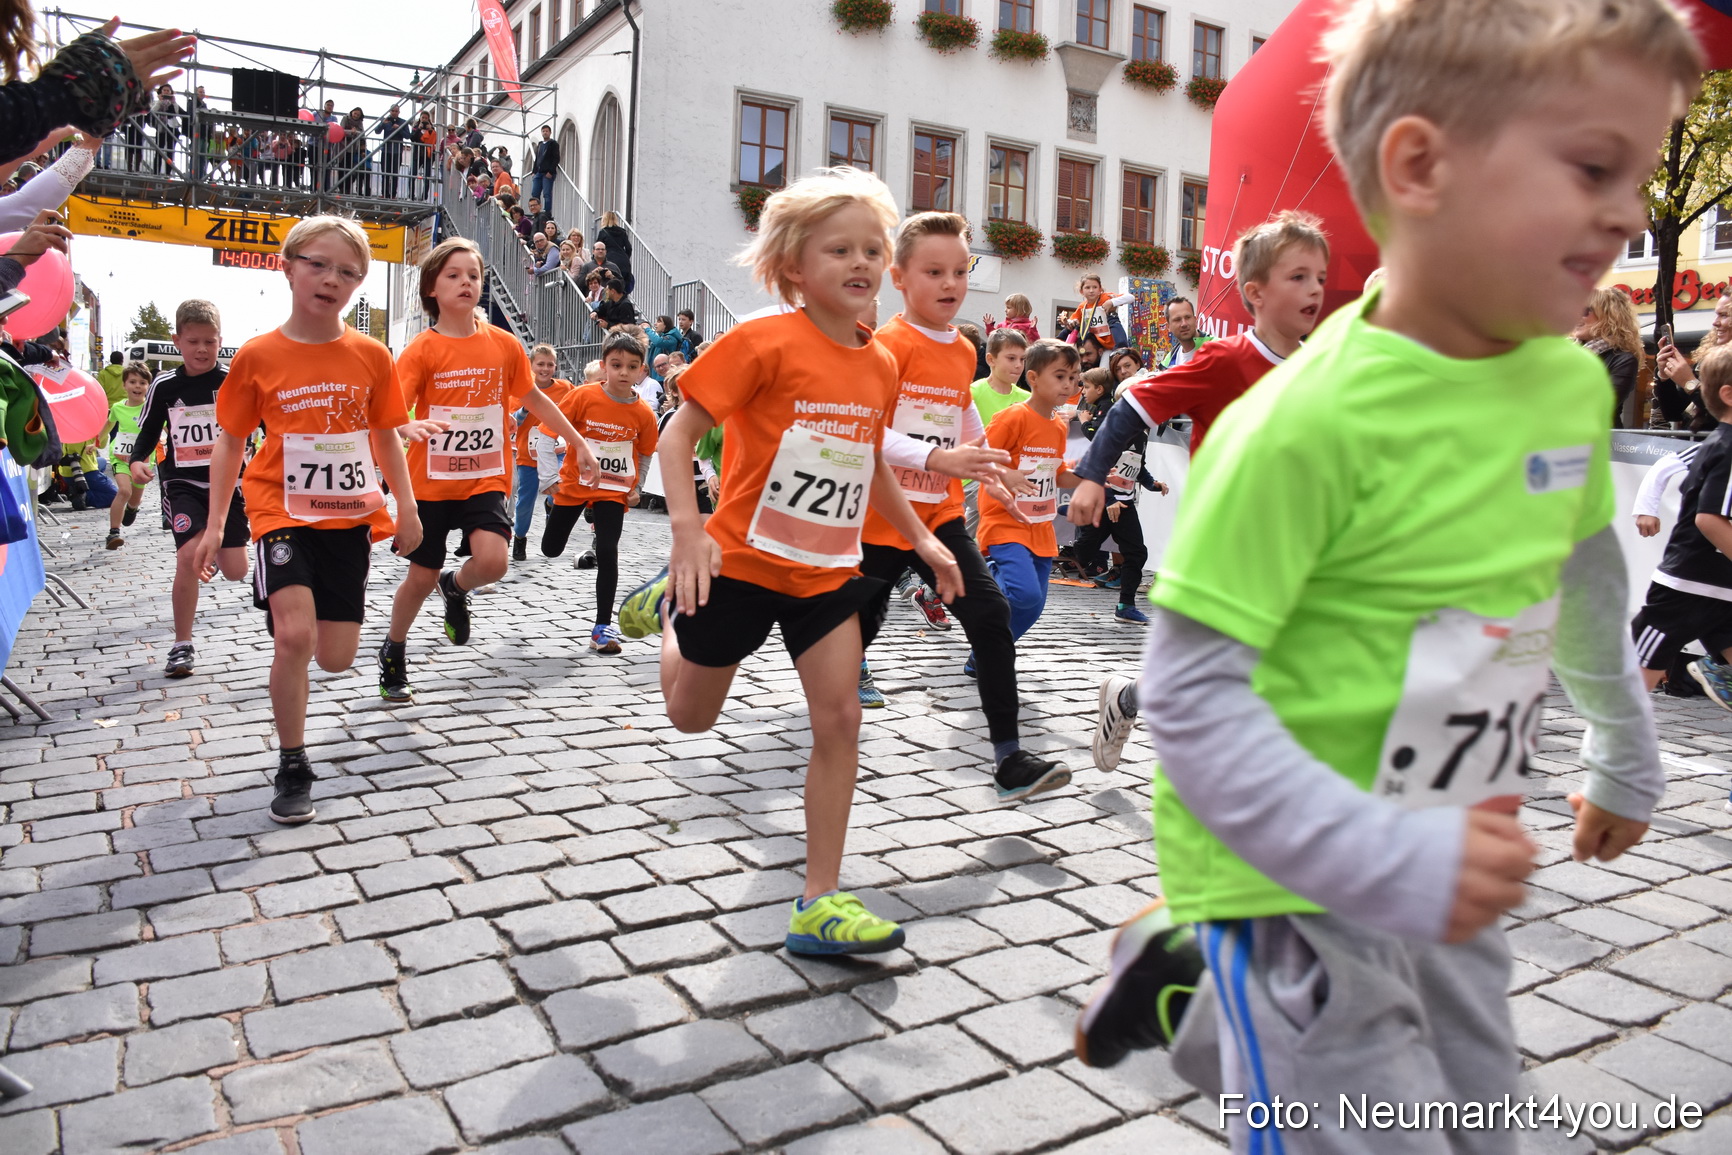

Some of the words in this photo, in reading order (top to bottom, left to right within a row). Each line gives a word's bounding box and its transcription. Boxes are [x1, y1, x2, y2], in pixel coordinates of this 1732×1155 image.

[205, 217, 280, 245] ZIEL
[1202, 245, 1237, 279] STO
[1672, 269, 1732, 311] Bec
[1091, 315, 1103, 326] 94
[157, 344, 183, 355] MIN
[433, 367, 486, 380] Neumarkter
[277, 382, 347, 401] Neumarkter
[434, 378, 476, 389] Stadtlauf
[901, 381, 959, 398] Neumarkter
[281, 395, 334, 414] Stadtlauf
[794, 400, 872, 418] Neumarkter
[586, 419, 624, 431] Neumarkter
[442, 428, 494, 451] 7232
[120, 443, 134, 454] 70
[449, 456, 480, 471] BEN
[832, 451, 864, 466] BOCK
[300, 461, 366, 491] 7135
[787, 470, 864, 520] 7213
[310, 499, 366, 510] Konstantin
